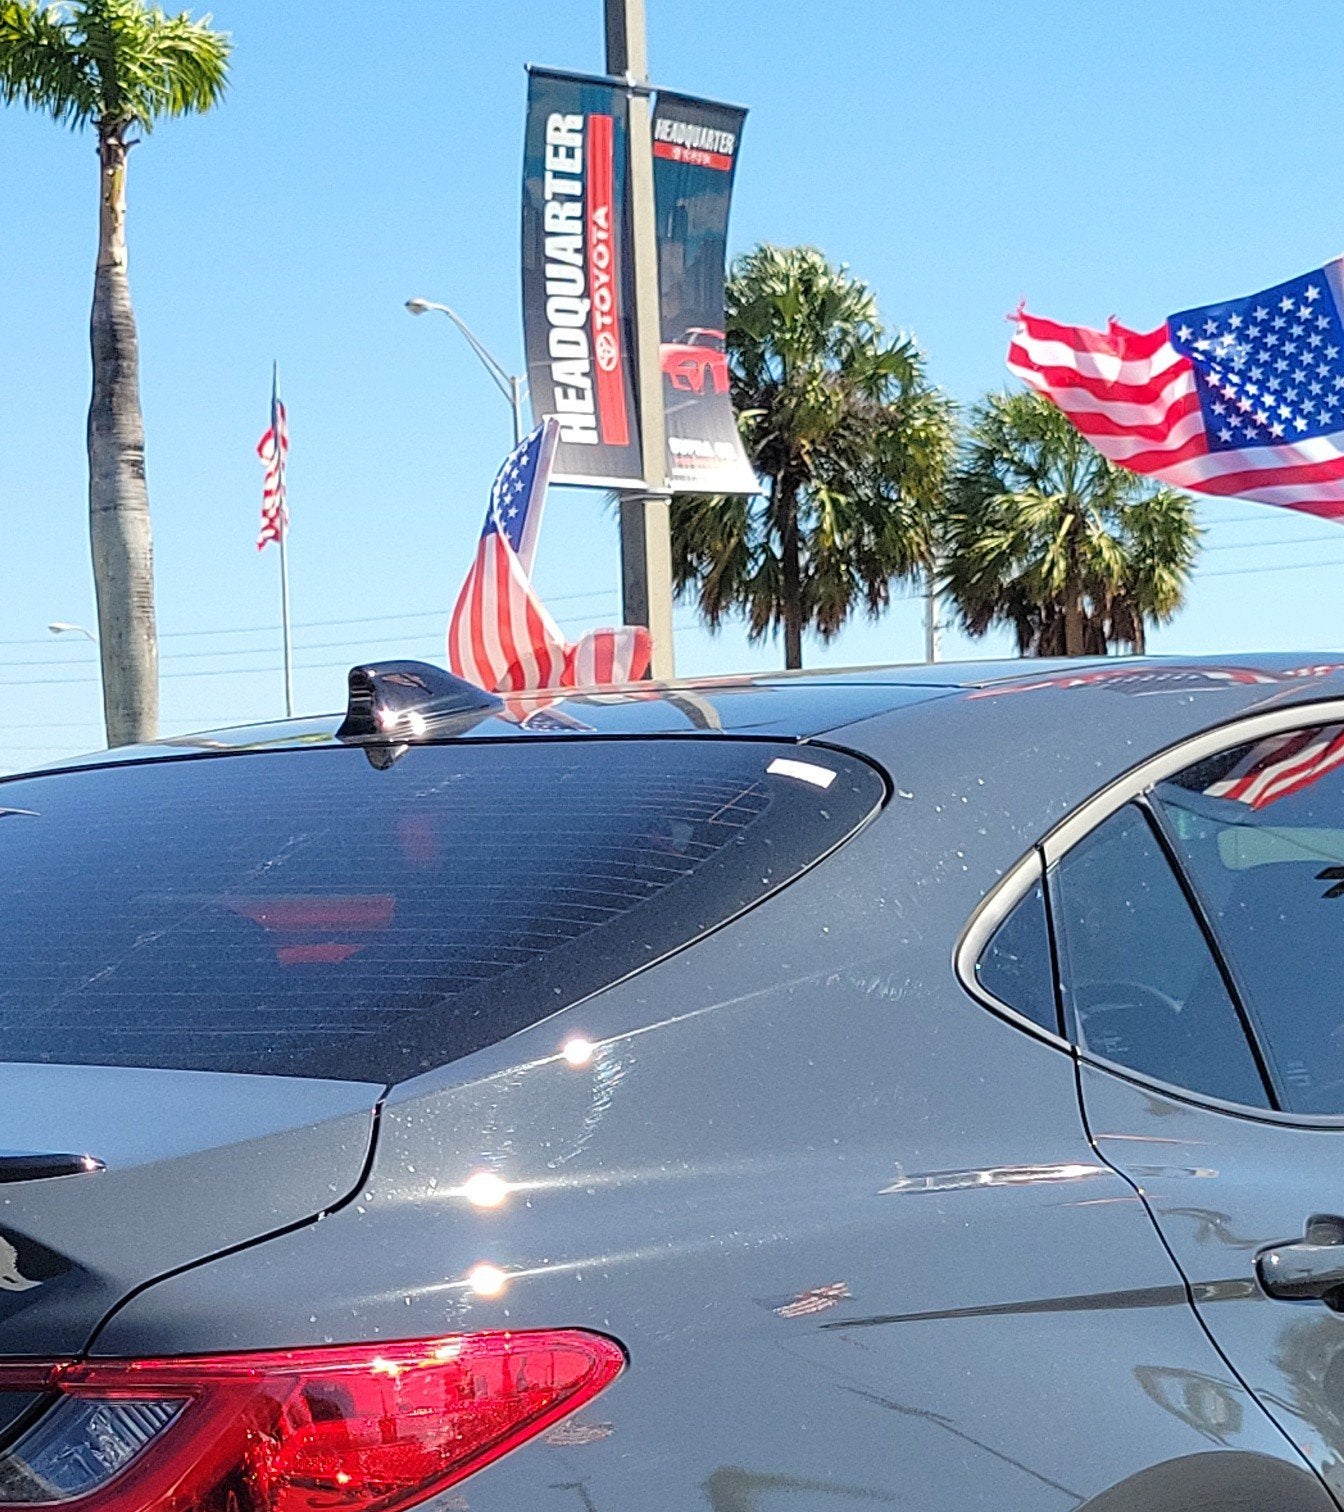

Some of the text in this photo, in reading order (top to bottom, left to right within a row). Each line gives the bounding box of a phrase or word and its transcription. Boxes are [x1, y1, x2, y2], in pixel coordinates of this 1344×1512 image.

[654, 118, 736, 155] HEADQUARTER
[544, 112, 599, 446] HEADQUARTER
[592, 206, 613, 330] TOYOTA
